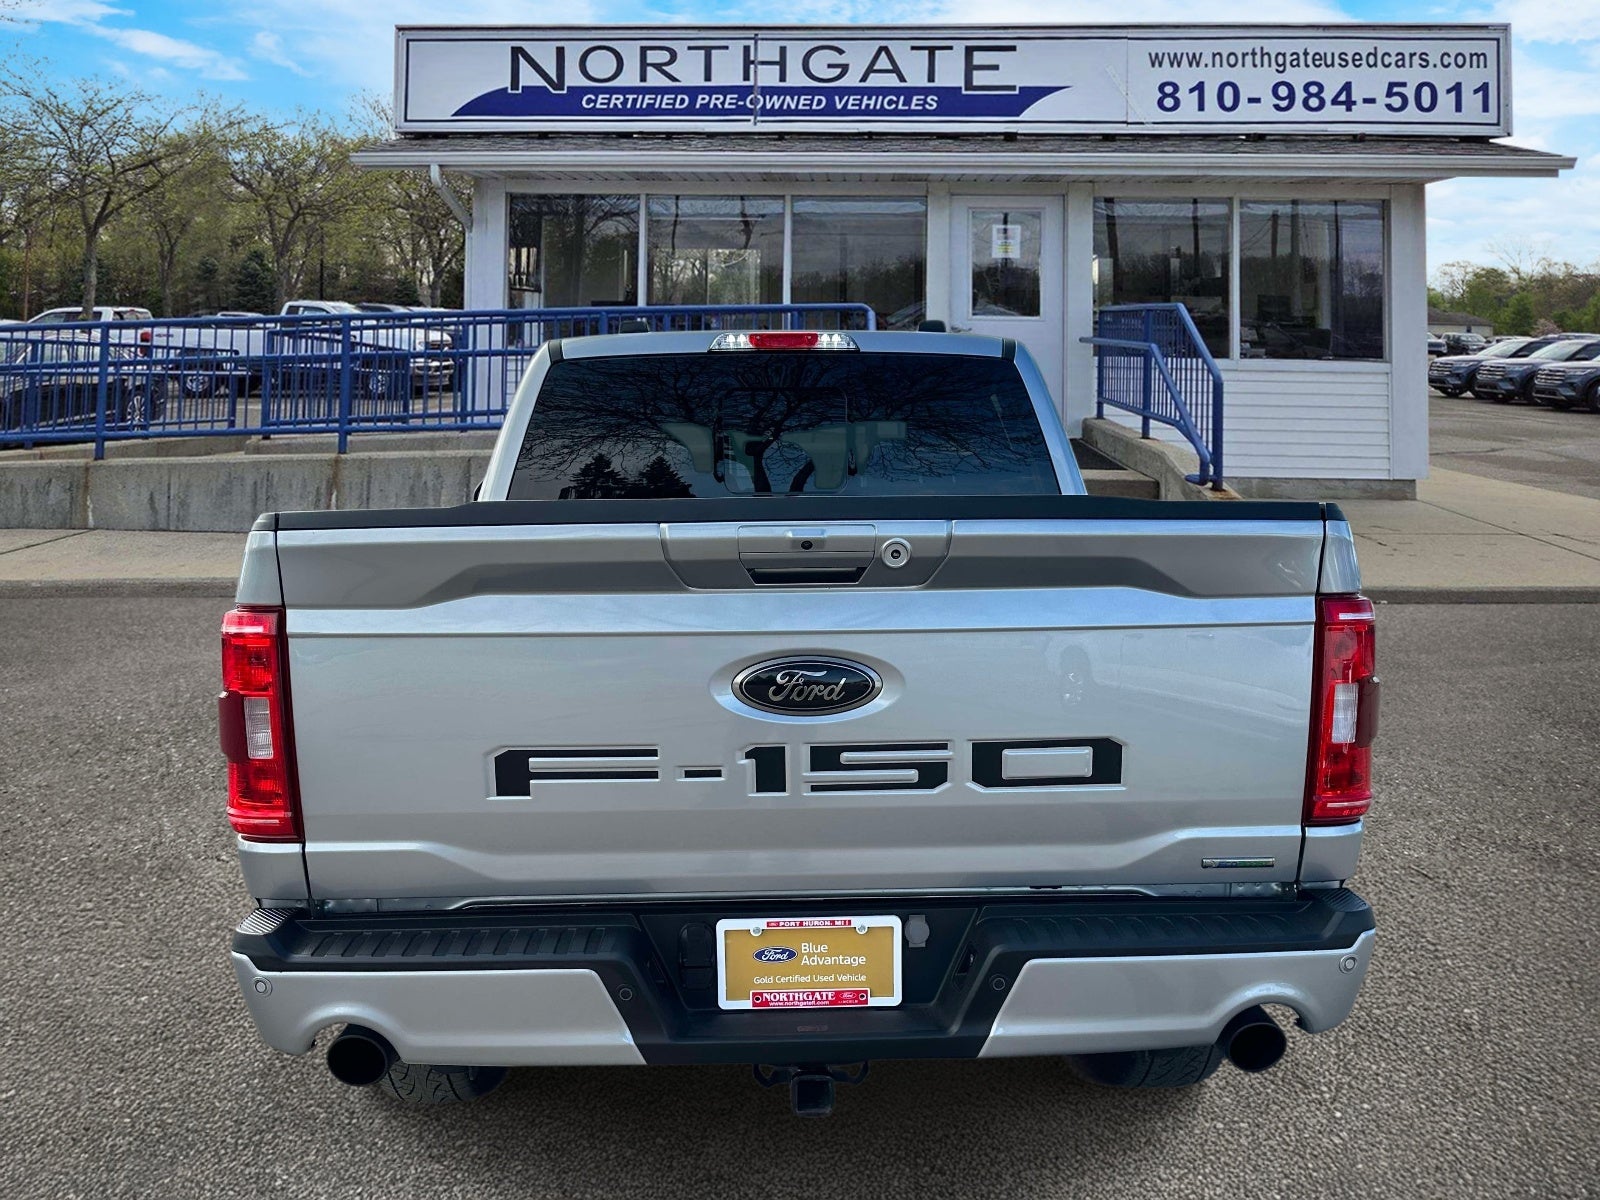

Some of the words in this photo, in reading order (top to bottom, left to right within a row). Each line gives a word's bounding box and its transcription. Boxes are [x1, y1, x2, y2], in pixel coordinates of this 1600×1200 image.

[1149, 46, 1488, 74] www.northgateusedcars.com
[509, 44, 1018, 94] NORTHGATE
[581, 94, 689, 109] CERTIFIED
[695, 94, 827, 110] PRE-OWNED
[834, 95, 938, 110] VEHICLES
[1156, 80, 1490, 114] 810-984-5011
[768, 669, 847, 702] Ford
[494, 738, 1123, 797] F-150
[761, 949, 789, 961] Ford
[801, 942, 828, 953] Blue
[801, 955, 866, 967] Advantage
[753, 976, 773, 984] Gold
[775, 975, 811, 983] Certified
[813, 974, 834, 982] Used
[836, 973, 867, 982] Vehicle
[762, 992, 836, 1002] NORTHGATE
